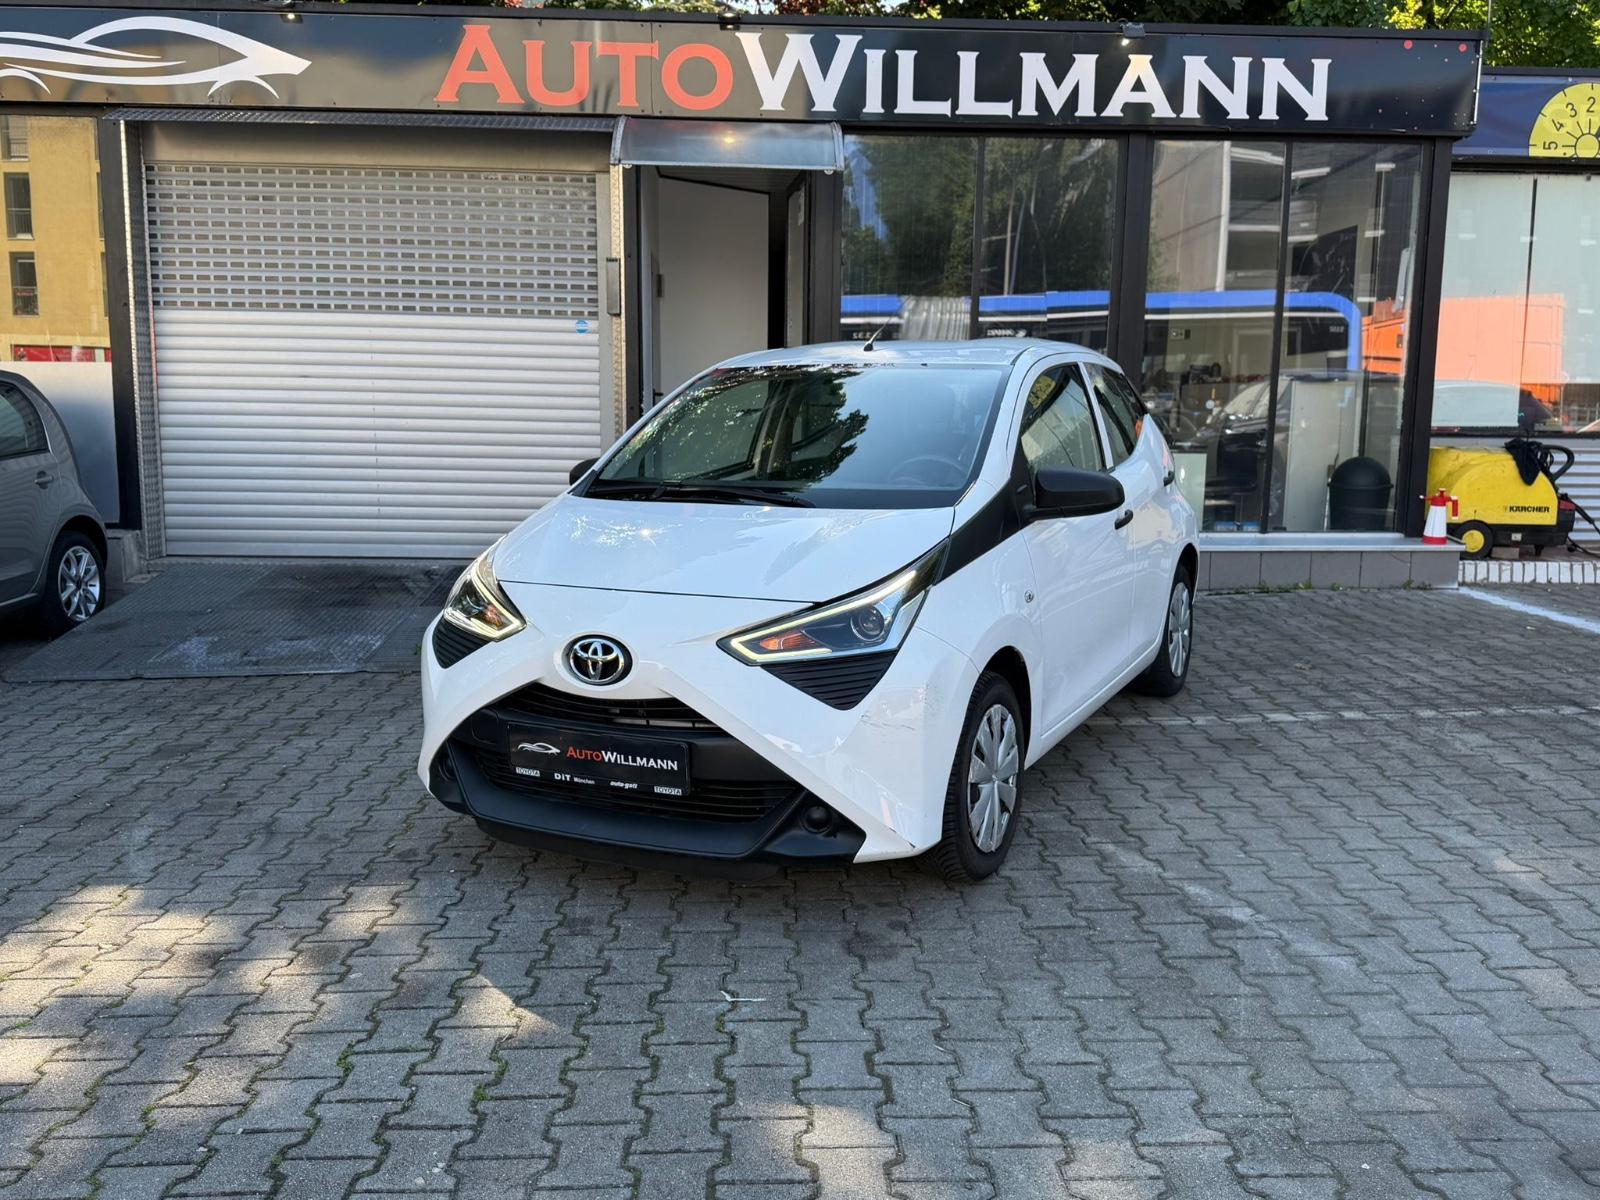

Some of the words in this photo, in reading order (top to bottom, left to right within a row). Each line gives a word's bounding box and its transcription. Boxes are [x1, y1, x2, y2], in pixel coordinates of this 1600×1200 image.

[435, 24, 1333, 121] AUTOWILLMANN
[1565, 102, 1578, 118] 3
[1586, 97, 1596, 113] 2
[1551, 118, 1565, 132] 4
[1542, 140, 1559, 151] 5
[1509, 505, 1550, 513] KÄRCHER
[566, 746, 679, 771] AUTOWILLMANN
[515, 767, 541, 777] TOYOTA
[554, 773, 572, 782] DIT
[654, 786, 682, 796] TOYOTA
